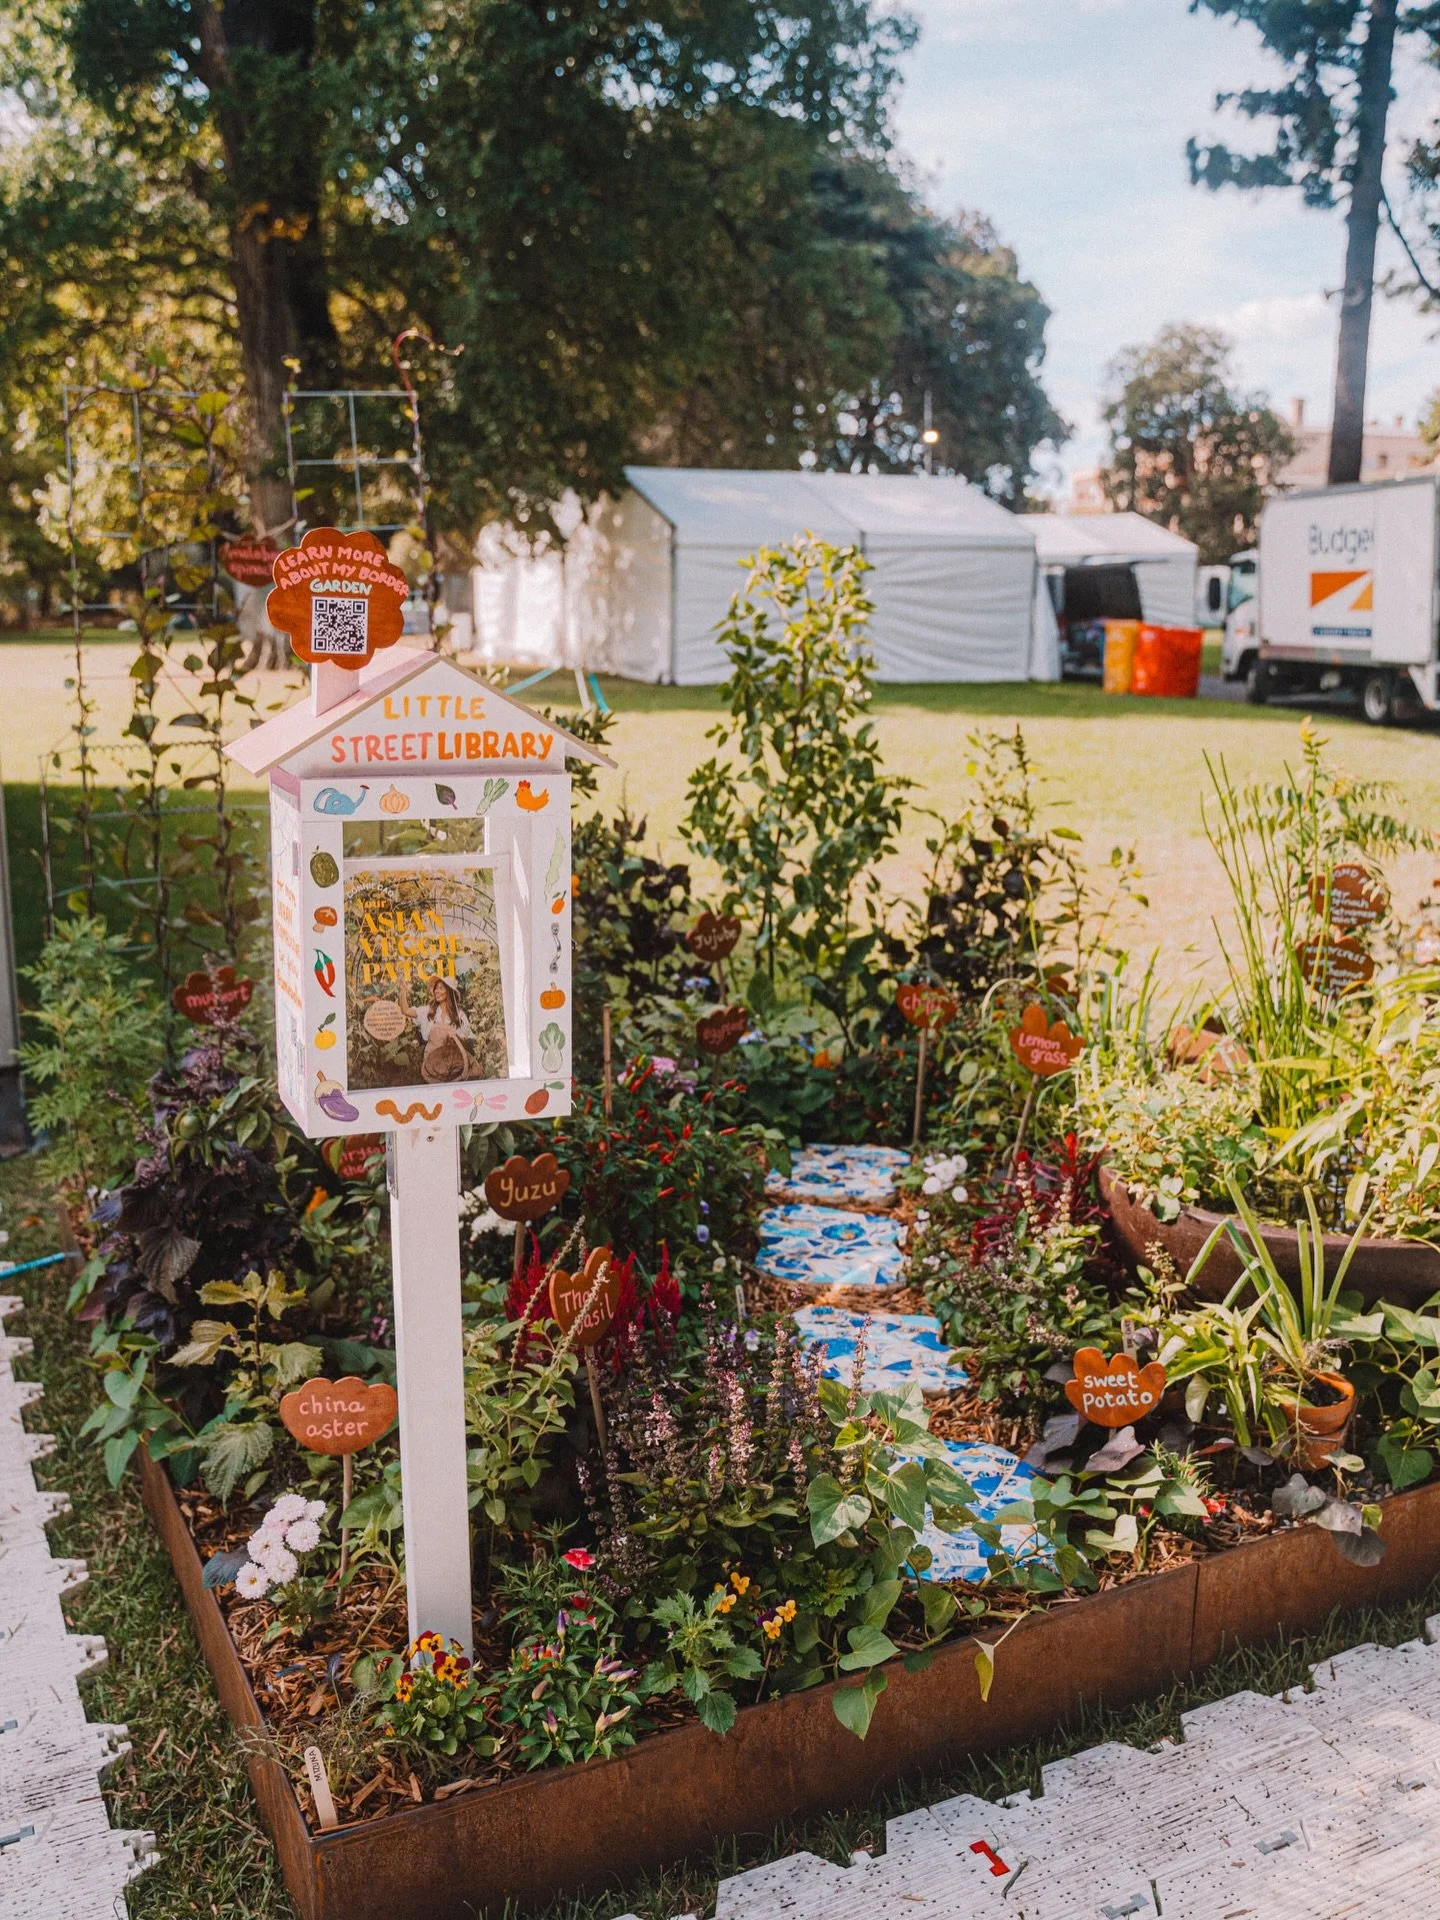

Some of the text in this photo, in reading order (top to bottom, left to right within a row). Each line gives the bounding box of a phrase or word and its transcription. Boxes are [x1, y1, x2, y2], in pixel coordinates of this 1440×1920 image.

[278, 546, 385, 572] LEARN MORE
[280, 562, 410, 597] ABOUT MY BORDER
[309, 578, 373, 596] GARDEN
[383, 695, 487, 721] LITTLE
[331, 730, 554, 763] STREET LIBRARY
[347, 882, 394, 898] CONNIE CAO
[356, 898, 387, 908] Your
[358, 910, 444, 934] ASIAN
[359, 929, 465, 958] VEGGIE
[361, 958, 457, 984] PATCH
[1019, 1031, 1061, 1051] Lemon
[1029, 1049, 1068, 1066] grass
[1083, 1370, 1139, 1389] sweet
[299, 1395, 366, 1416] china
[306, 1419, 369, 1439] aster
